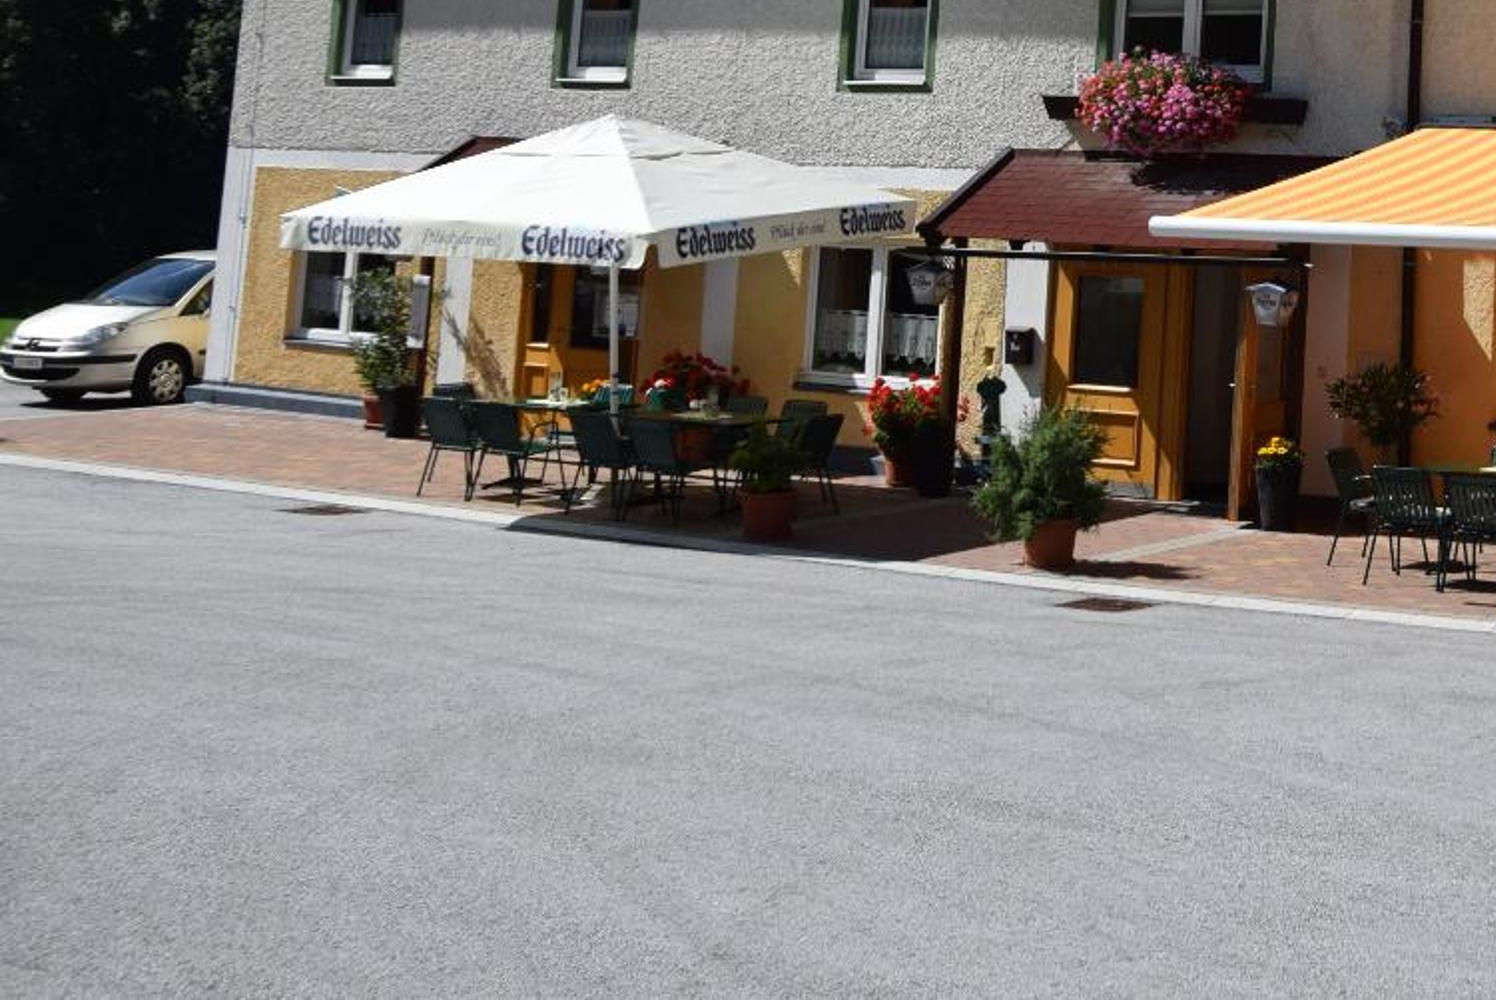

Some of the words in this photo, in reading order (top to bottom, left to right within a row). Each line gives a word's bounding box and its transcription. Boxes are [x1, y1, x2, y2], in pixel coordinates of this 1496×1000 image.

[307, 215, 403, 250] Edelweiss
[839, 203, 906, 236] Edelweiss
[521, 224, 627, 262] Edelweiss
[676, 221, 756, 259] Edelweiss
